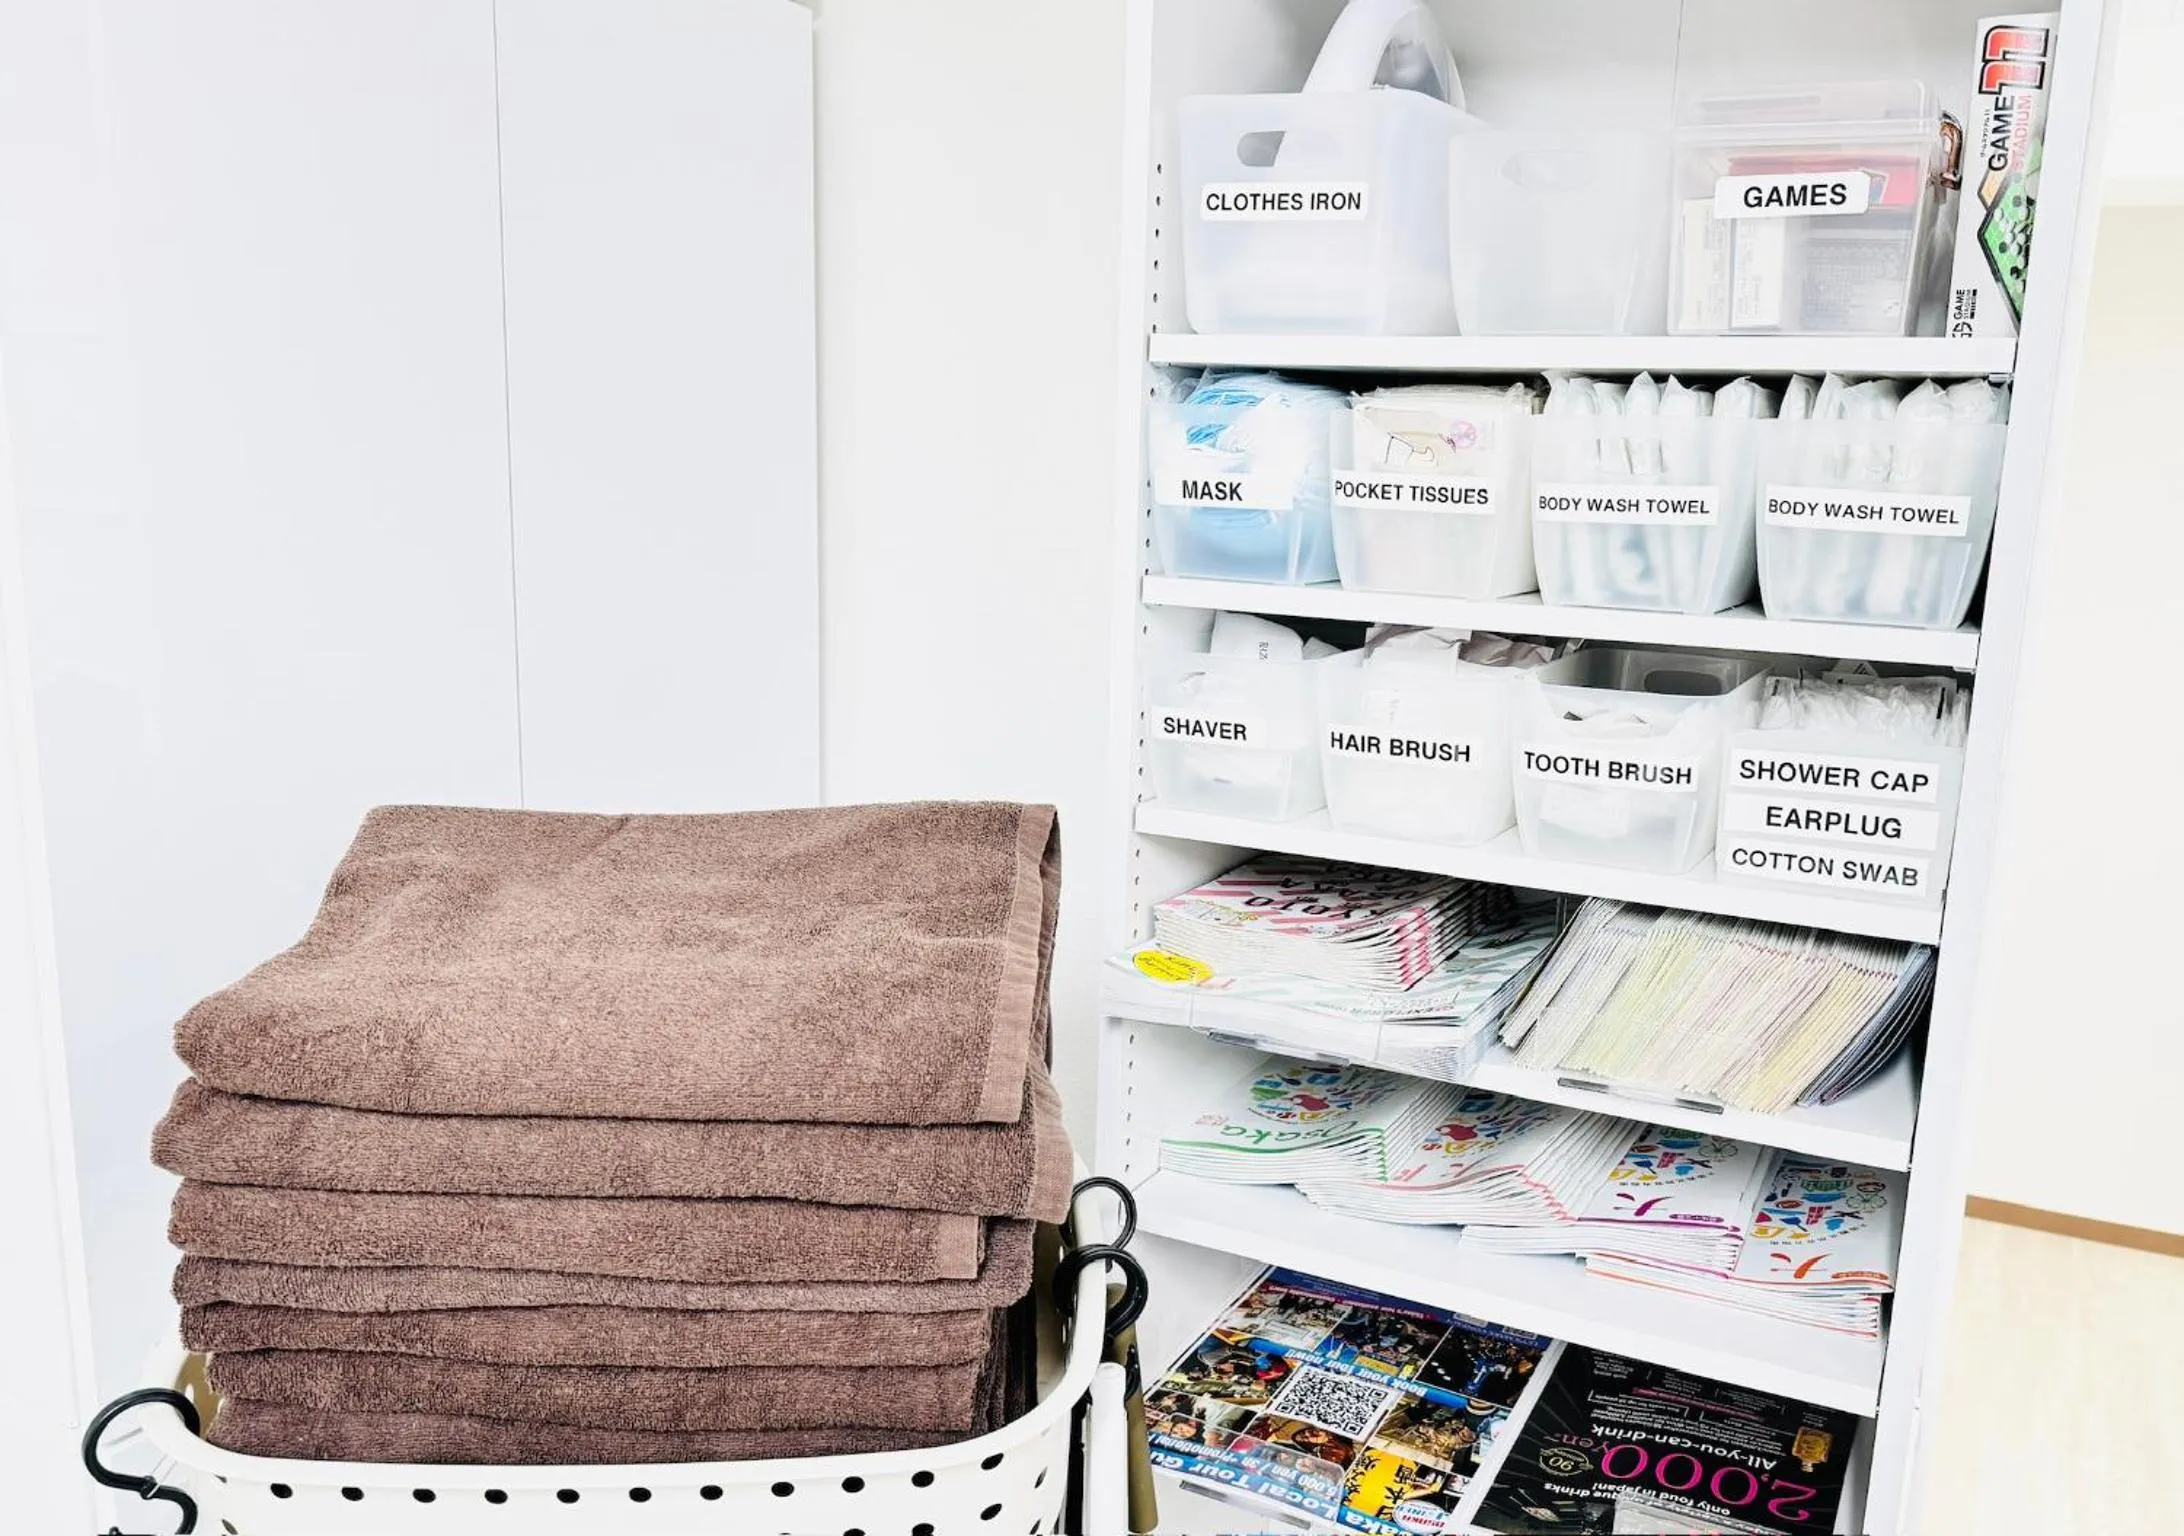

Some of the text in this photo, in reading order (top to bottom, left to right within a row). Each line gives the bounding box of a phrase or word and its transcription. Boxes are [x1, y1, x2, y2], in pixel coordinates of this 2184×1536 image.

[1978, 24, 2050, 95] 11
[1988, 95, 2016, 172] GAME
[2011, 95, 2032, 172] STADIUM
[1206, 192, 1361, 211] CLOTHES IRON
[1743, 183, 1847, 208] GAMES
[1953, 289, 1965, 320] GAME
[1182, 479, 1243, 502] MASK
[1335, 480, 1489, 505] POCKET TISSUES
[1539, 495, 1710, 514] BODY WASH TOWEL
[1768, 498, 1959, 524] BODY WASH TOWEL
[1163, 716, 1247, 741] SHAVER
[1330, 731, 1470, 763] HAIR BRUSH
[1524, 751, 1692, 785] TOOTH BRUSH
[1739, 759, 1929, 793] SHOWER CAP
[1766, 805, 1902, 839] EARPLUG
[1732, 848, 1918, 887] COTTON SWAB
[1220, 1120, 1358, 1145] Osaka
[1590, 1422, 1778, 1471] All-you-can-drink
[1188, 1459, 1250, 1489] Tour
[1547, 1456, 1576, 1471] 90
[1543, 1482, 1591, 1498] drinks
[1600, 1443, 1818, 1522] 2,000
[1643, 1489, 1657, 1500] in
[1257, 1481, 1339, 1522] Local
[1660, 1491, 1695, 1507] foud
[1697, 1500, 1731, 1516] only
